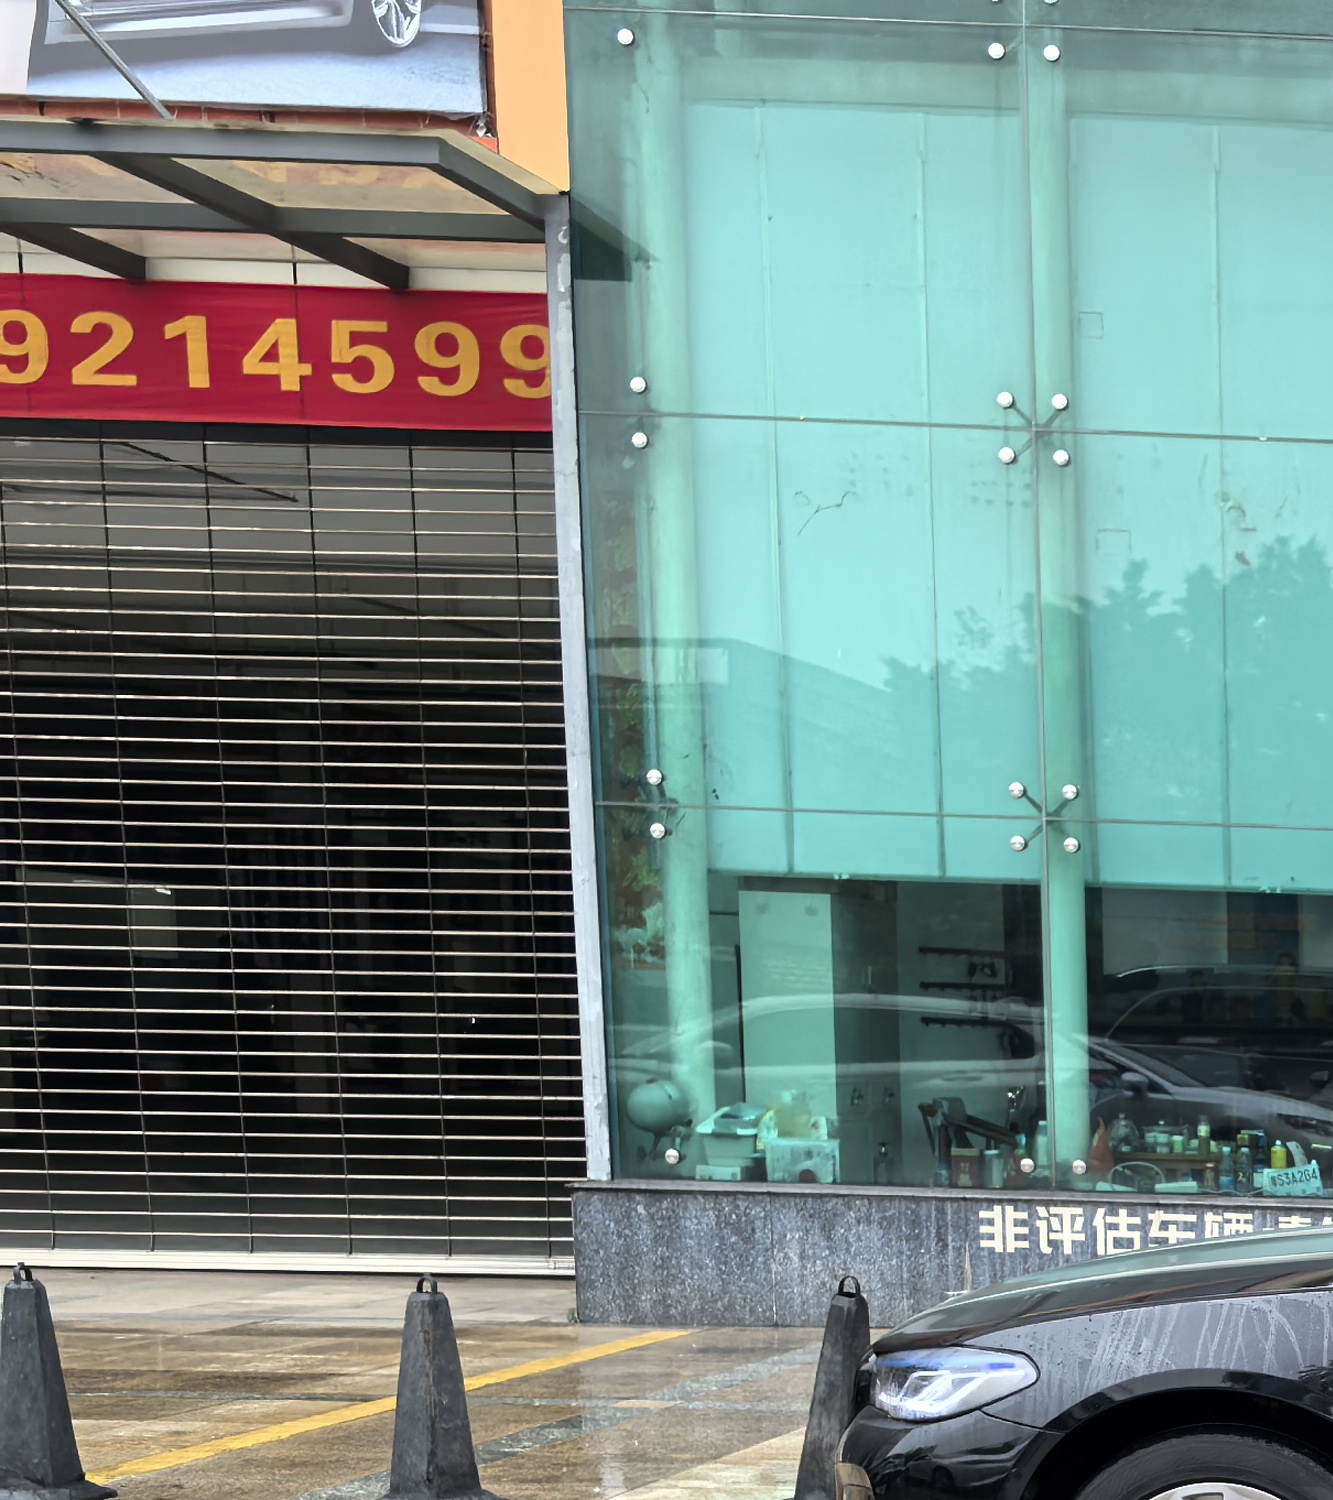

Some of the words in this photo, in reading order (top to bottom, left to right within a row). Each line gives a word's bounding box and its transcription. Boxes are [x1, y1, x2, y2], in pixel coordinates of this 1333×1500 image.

[0, 309, 552, 399] 9214599
[978, 1204, 1333, 1256] 非评估车辆
